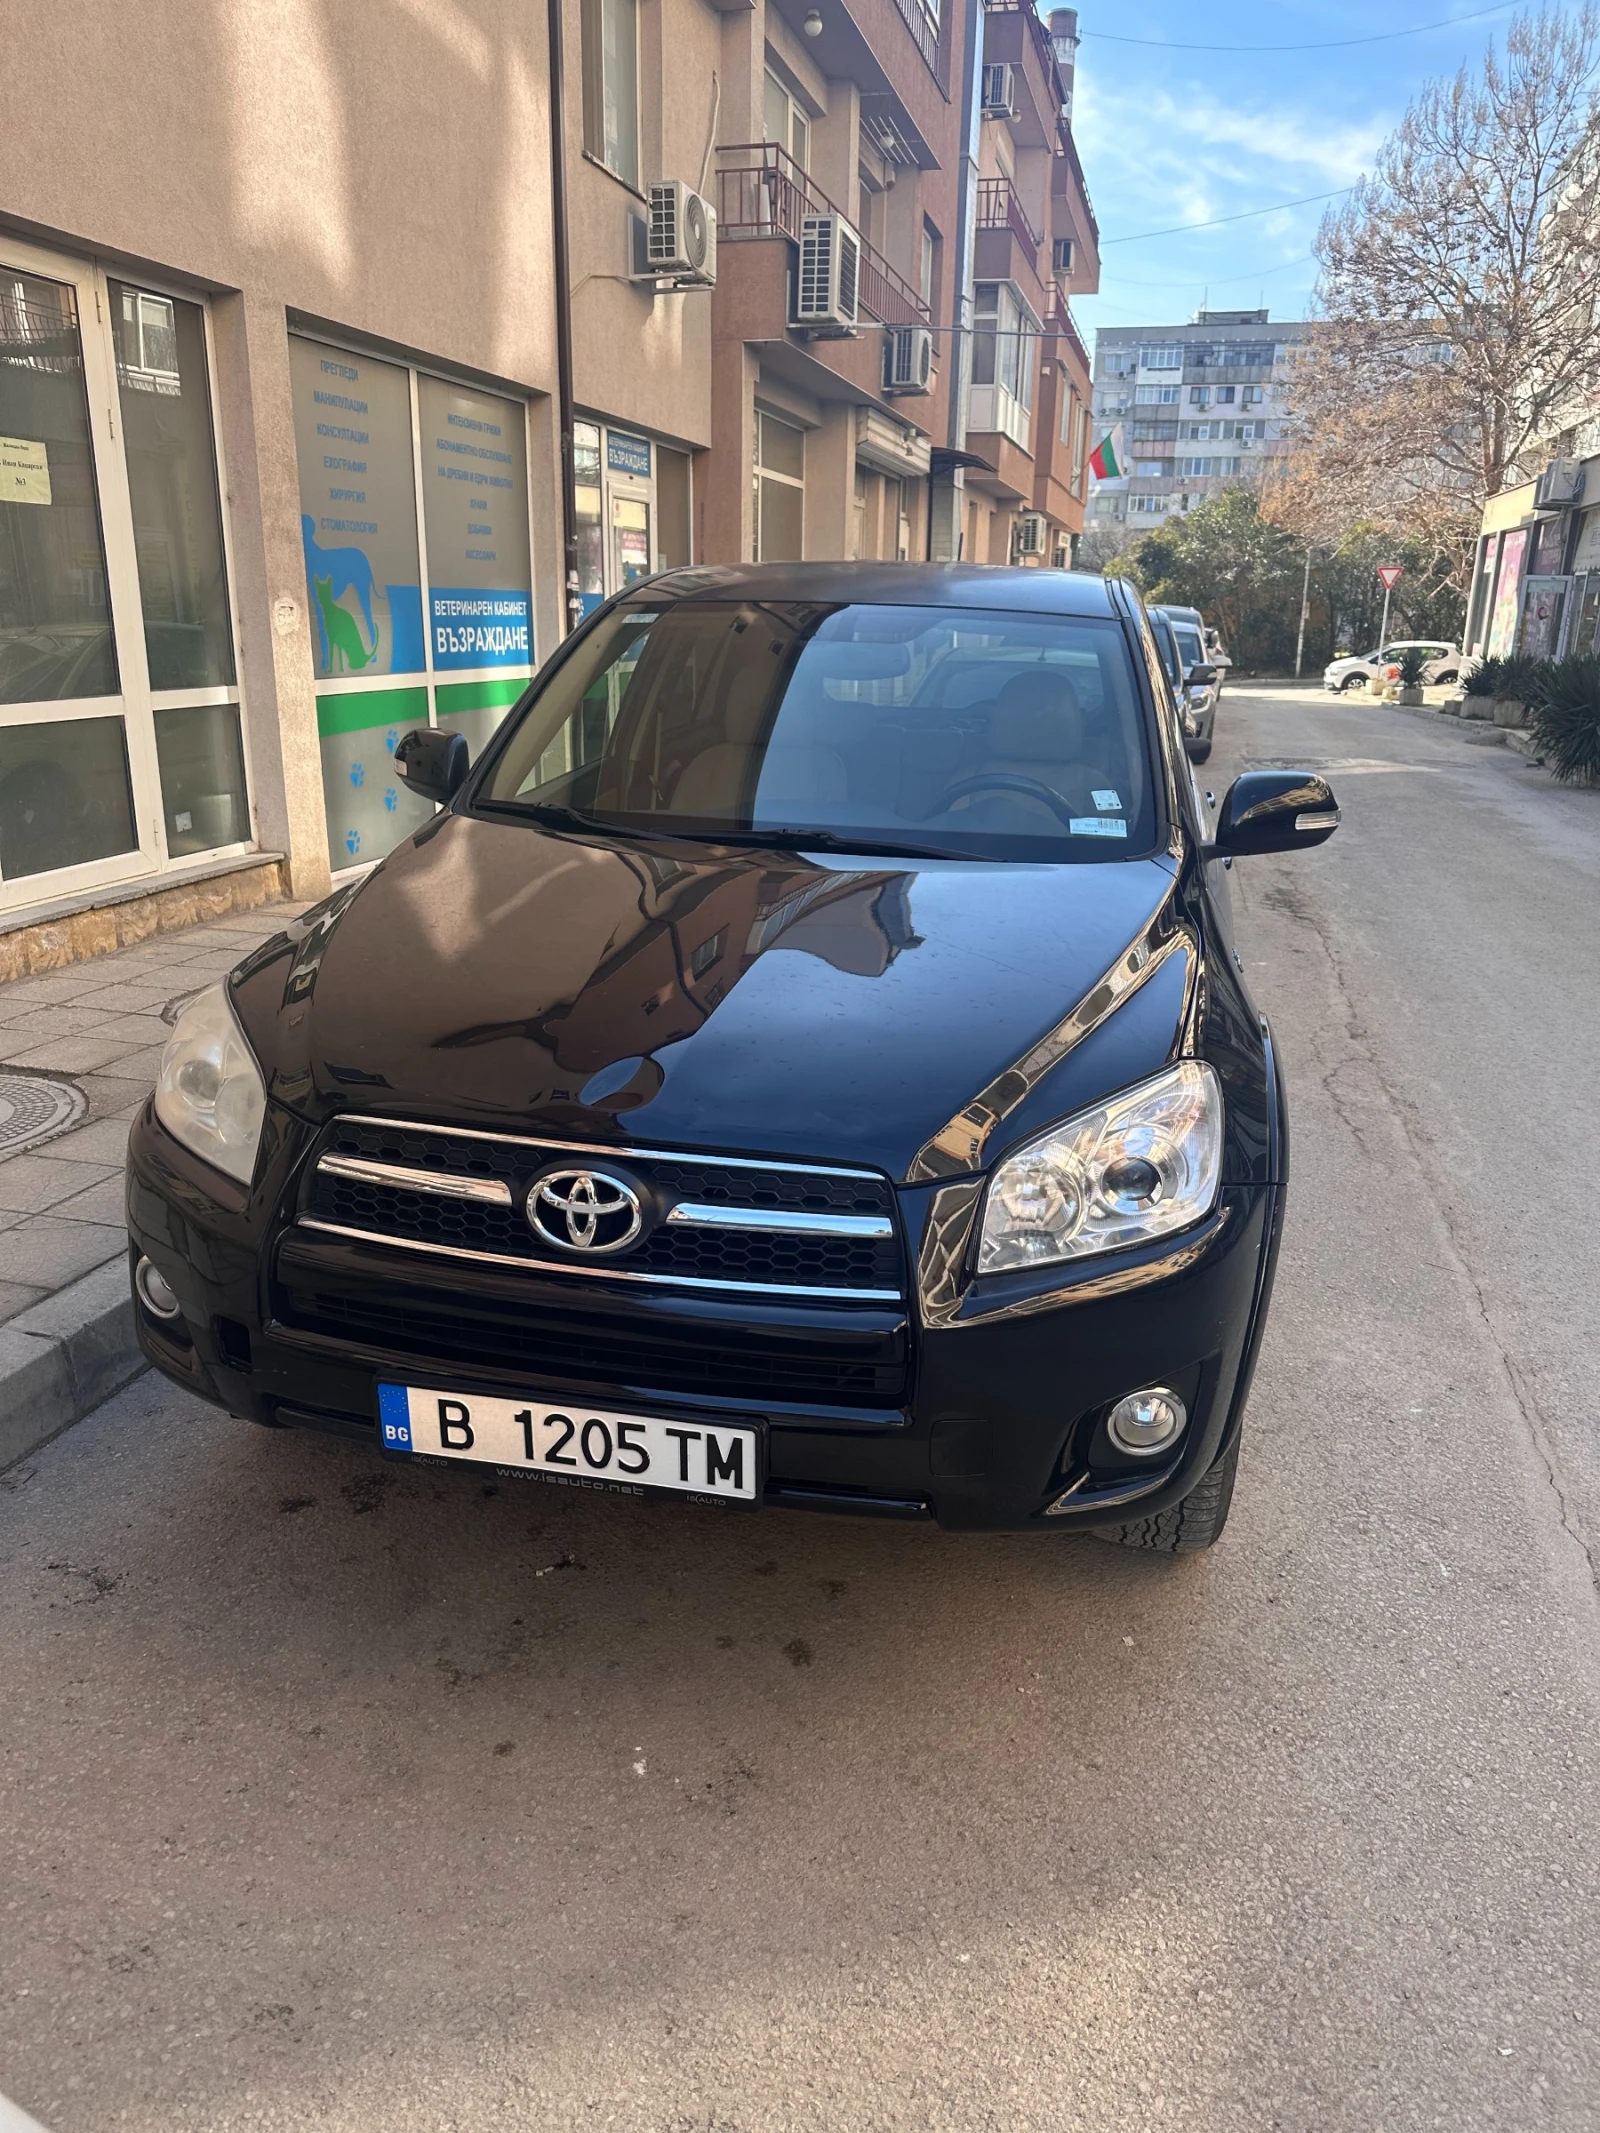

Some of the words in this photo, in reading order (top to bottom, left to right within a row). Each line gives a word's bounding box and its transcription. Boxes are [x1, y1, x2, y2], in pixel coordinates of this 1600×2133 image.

[320, 359, 359, 382] ПРЕГЛЕДИ
[313, 390, 368, 414] МАНИПУЛАЦИИ
[316, 422, 369, 445] КОНСУЛТАЦИИ
[323, 455, 367, 474] ЕХОГРАФИЯ
[609, 447, 648, 471] ВЪЗРАЖДАНЕ
[437, 465, 446, 477] НА
[329, 486, 366, 503] ХИРУРГИЯ
[320, 517, 378, 534] СТОМАТОЛОГИЯ
[435, 600, 493, 616] ВЕТЕРИНАРЕН
[494, 601, 527, 616] КАБИНЕТ
[436, 626, 529, 656] ВЪЗРАЖДАНЕ
[385, 1425, 409, 1442] BG
[437, 1398, 476, 1451] B
[514, 1408, 651, 1474] 1205
[664, 1426, 744, 1490] TM
[496, 1467, 644, 1497] www.isauto.net
